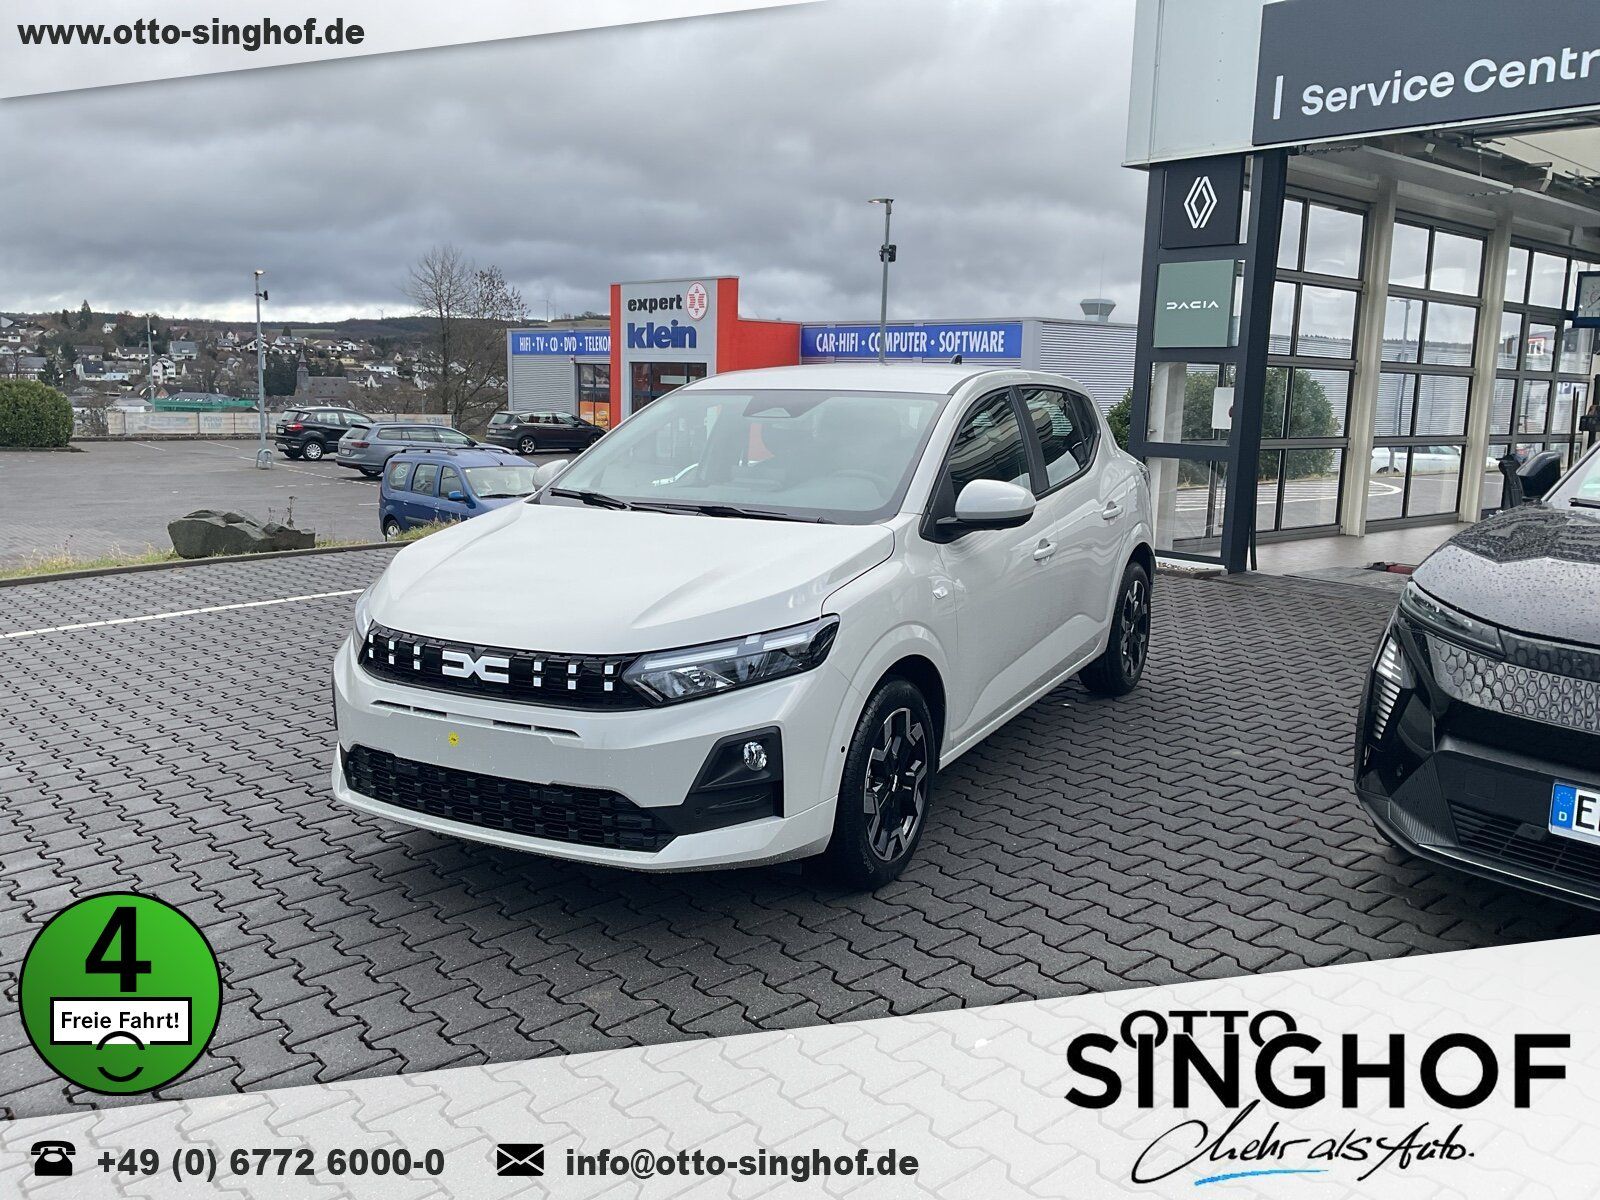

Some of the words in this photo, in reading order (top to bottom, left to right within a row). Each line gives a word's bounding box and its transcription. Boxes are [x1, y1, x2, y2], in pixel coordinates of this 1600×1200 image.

[1301, 69, 1455, 116] Service
[1464, 47, 1600, 93] Centr
[627, 294, 682, 314] expert
[1166, 300, 1219, 310] DACIA
[519, 337, 531, 352] HIFI
[536, 337, 545, 352] TV
[549, 337, 558, 352] CD
[564, 337, 577, 352] DVD
[627, 319, 697, 349] klein
[816, 333, 859, 353] CAR-HIFI
[938, 330, 1005, 353] SOFTWARE
[1575, 794, 1600, 832] E
